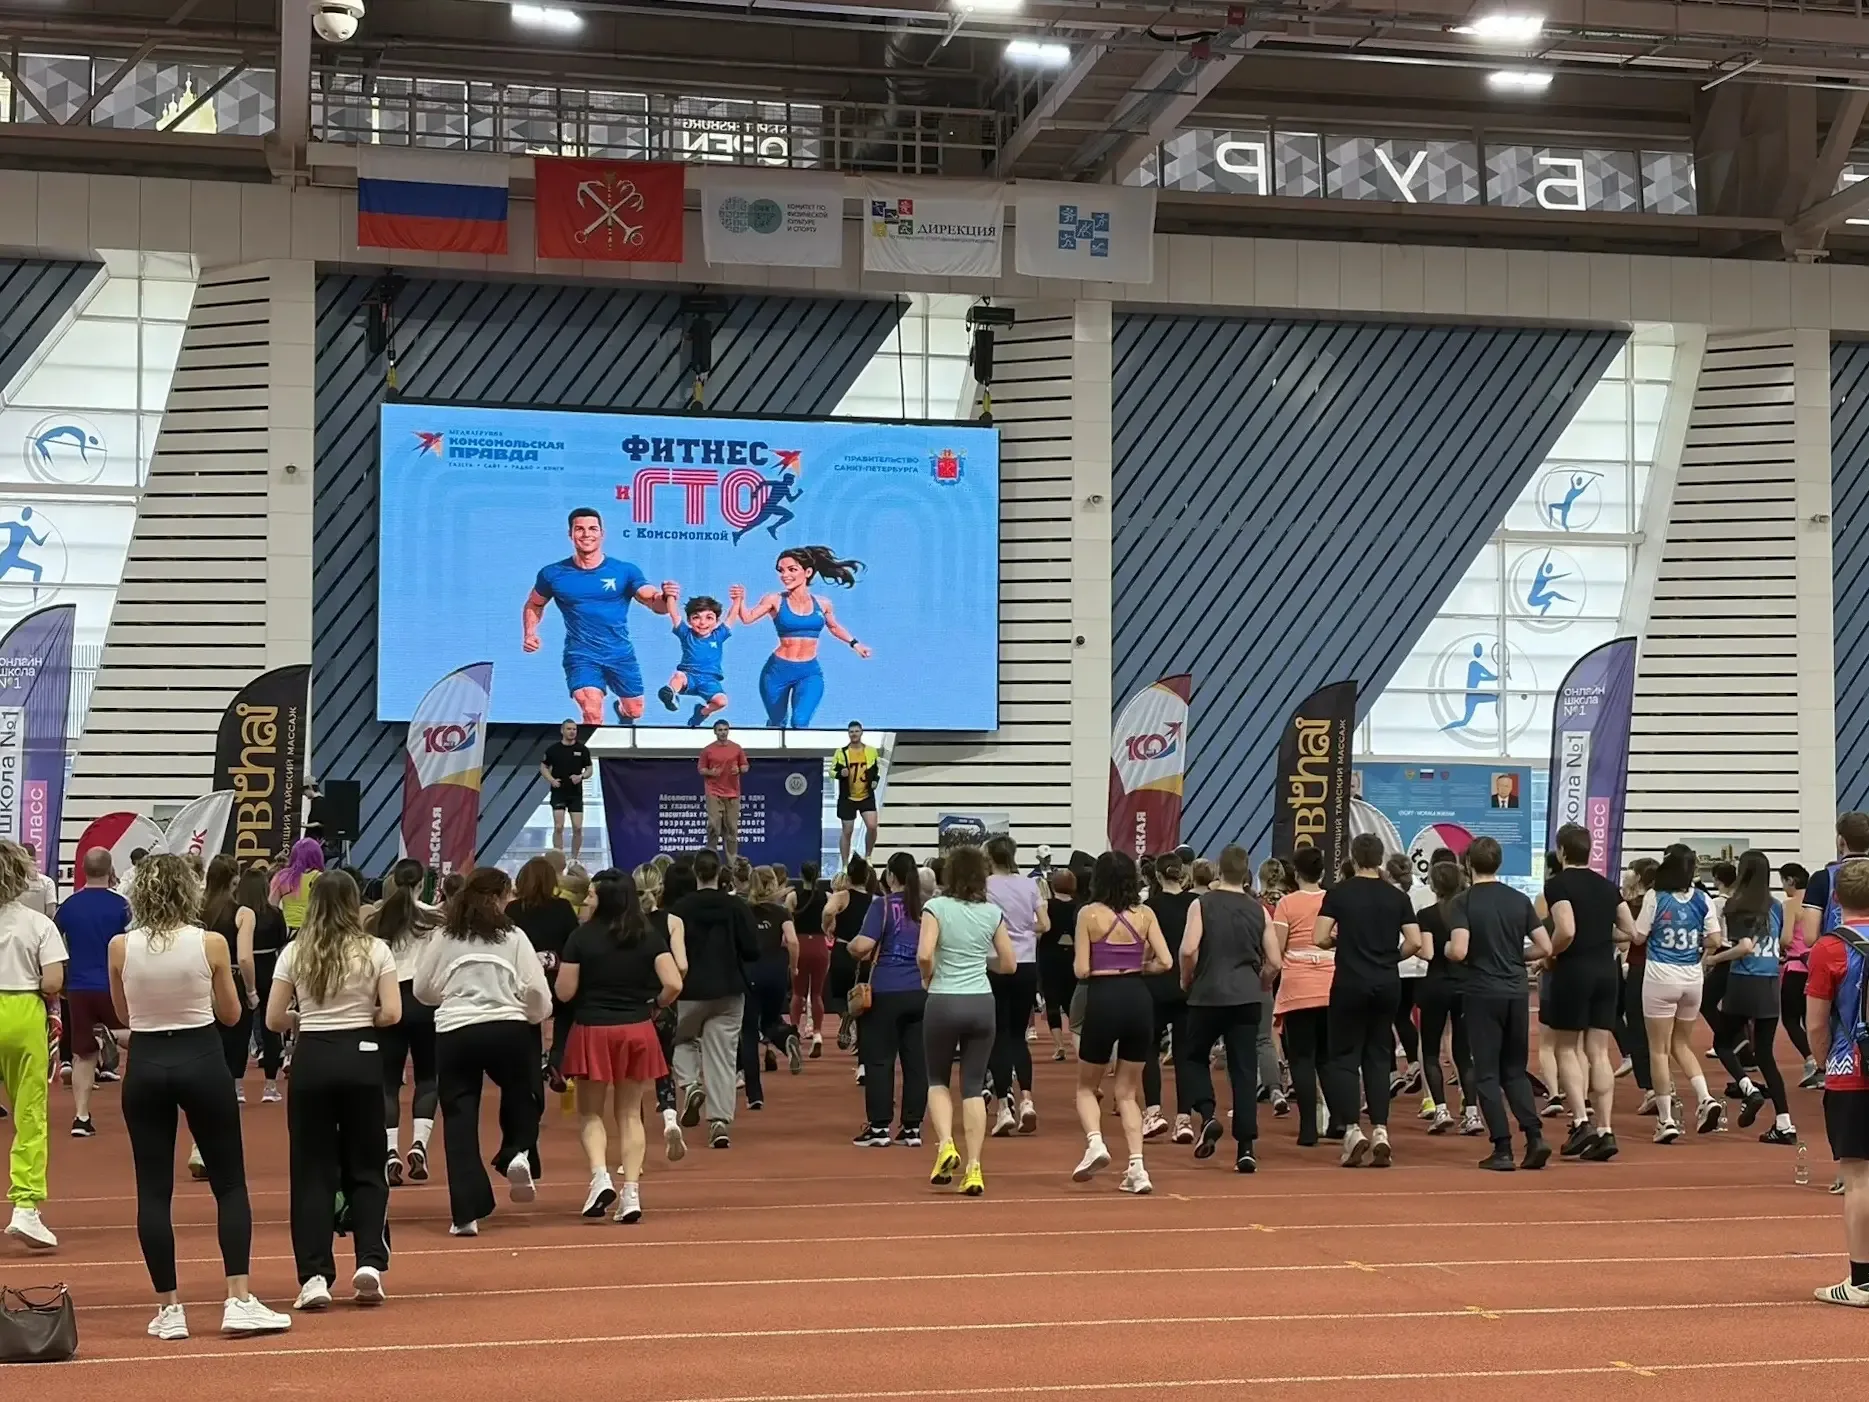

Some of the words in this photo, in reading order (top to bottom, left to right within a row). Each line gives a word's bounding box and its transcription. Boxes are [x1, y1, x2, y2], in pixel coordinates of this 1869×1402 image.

[917, 222, 996, 237] ДИРЕКЦИЯ
[449, 437, 565, 450] КОМСОМОЛЬСКАЯ
[449, 446, 539, 462] ПРАВДА
[621, 434, 769, 466] ФИТНЕС
[834, 464, 919, 474] САНКТ-ПЕТЕРБУРГА
[844, 454, 920, 464] ПРАВИТЕЛЬСТВО
[633, 467, 769, 530] ГТО
[0, 654, 43, 667] онлайн
[0, 667, 36, 677] школа
[1564, 685, 1606, 696] онлайн
[1564, 696, 1599, 705] школа
[287, 706, 298, 755] МАССАЖ
[1338, 719, 1347, 765] МАССАЖ
[850, 762, 868, 783] 73
[0, 756, 15, 834] школа
[284, 758, 294, 811] ТАЙСКИЙ
[1335, 768, 1345, 816] ТАЙСКИЙ
[1566, 775, 1581, 826] кола
[281, 813, 292, 857] ОЯЩИЙ
[1593, 803, 1606, 862] класс
[1661, 928, 1698, 950] 331
